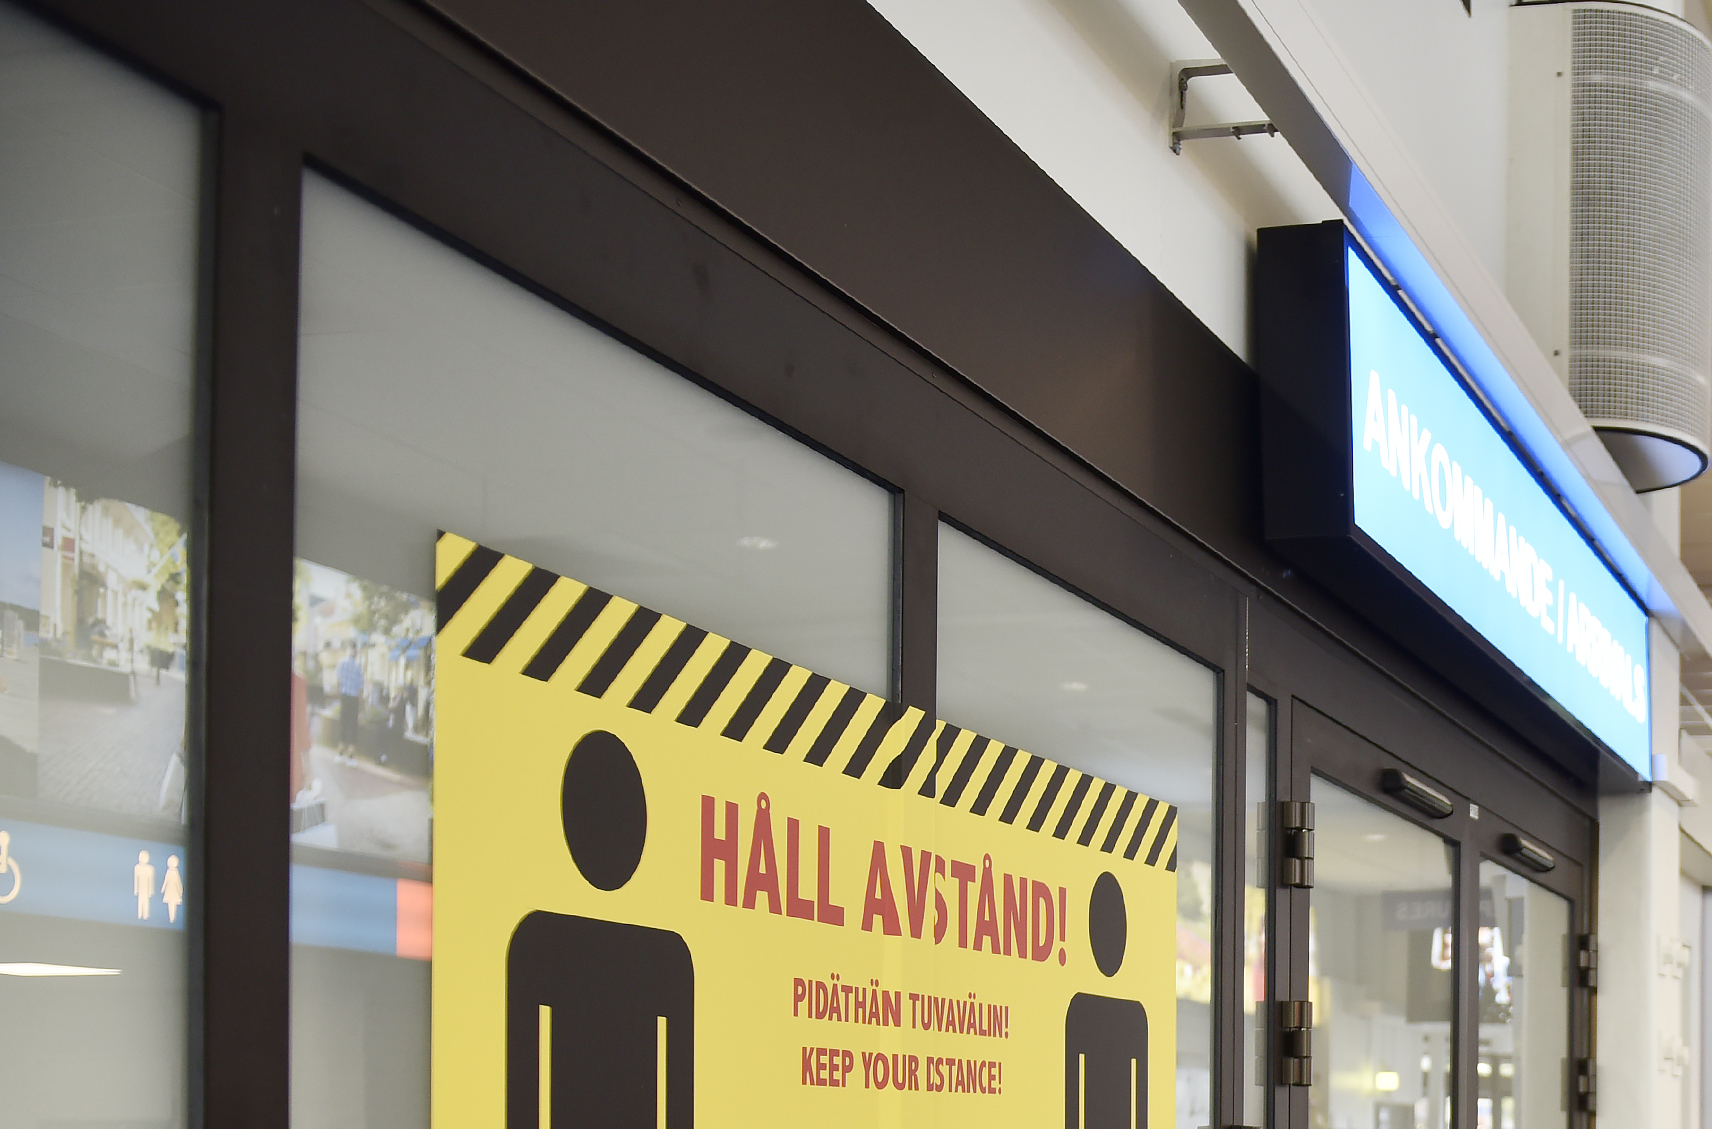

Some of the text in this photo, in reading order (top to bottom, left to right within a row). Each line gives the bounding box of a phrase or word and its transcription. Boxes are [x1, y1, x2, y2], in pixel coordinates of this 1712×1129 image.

[1363, 370, 1555, 635] ANKOMMANDE
[700, 791, 1068, 967] HÅLL AVSTÅND!
[793, 972, 1009, 1040] PIDÄTHÄN TUVAVÄLIN!
[801, 1046, 1002, 1095] KEEP YOUR DSTANCE!
